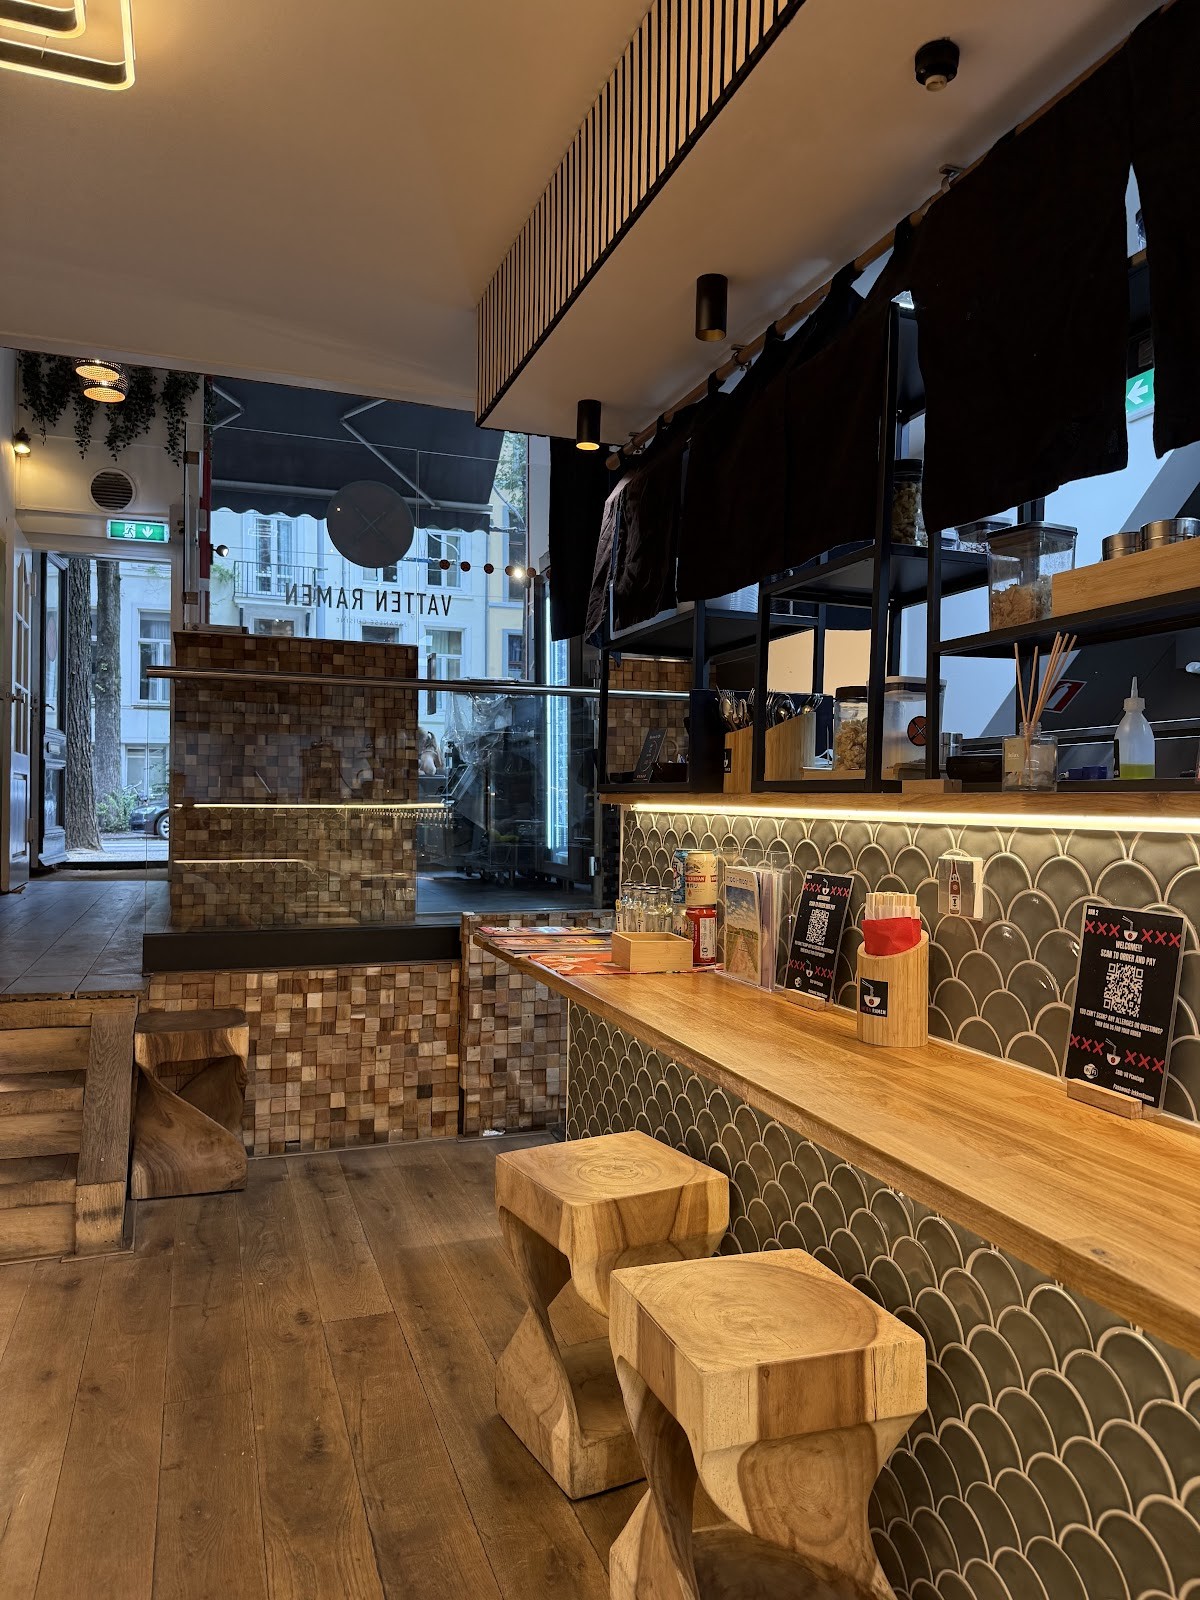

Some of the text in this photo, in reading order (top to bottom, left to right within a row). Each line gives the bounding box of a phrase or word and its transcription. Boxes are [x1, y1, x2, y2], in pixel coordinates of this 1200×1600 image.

[1100, 948, 1157, 967] SCAN TO ORDER AND PAY
[1107, 1014, 1116, 1023] ANY
